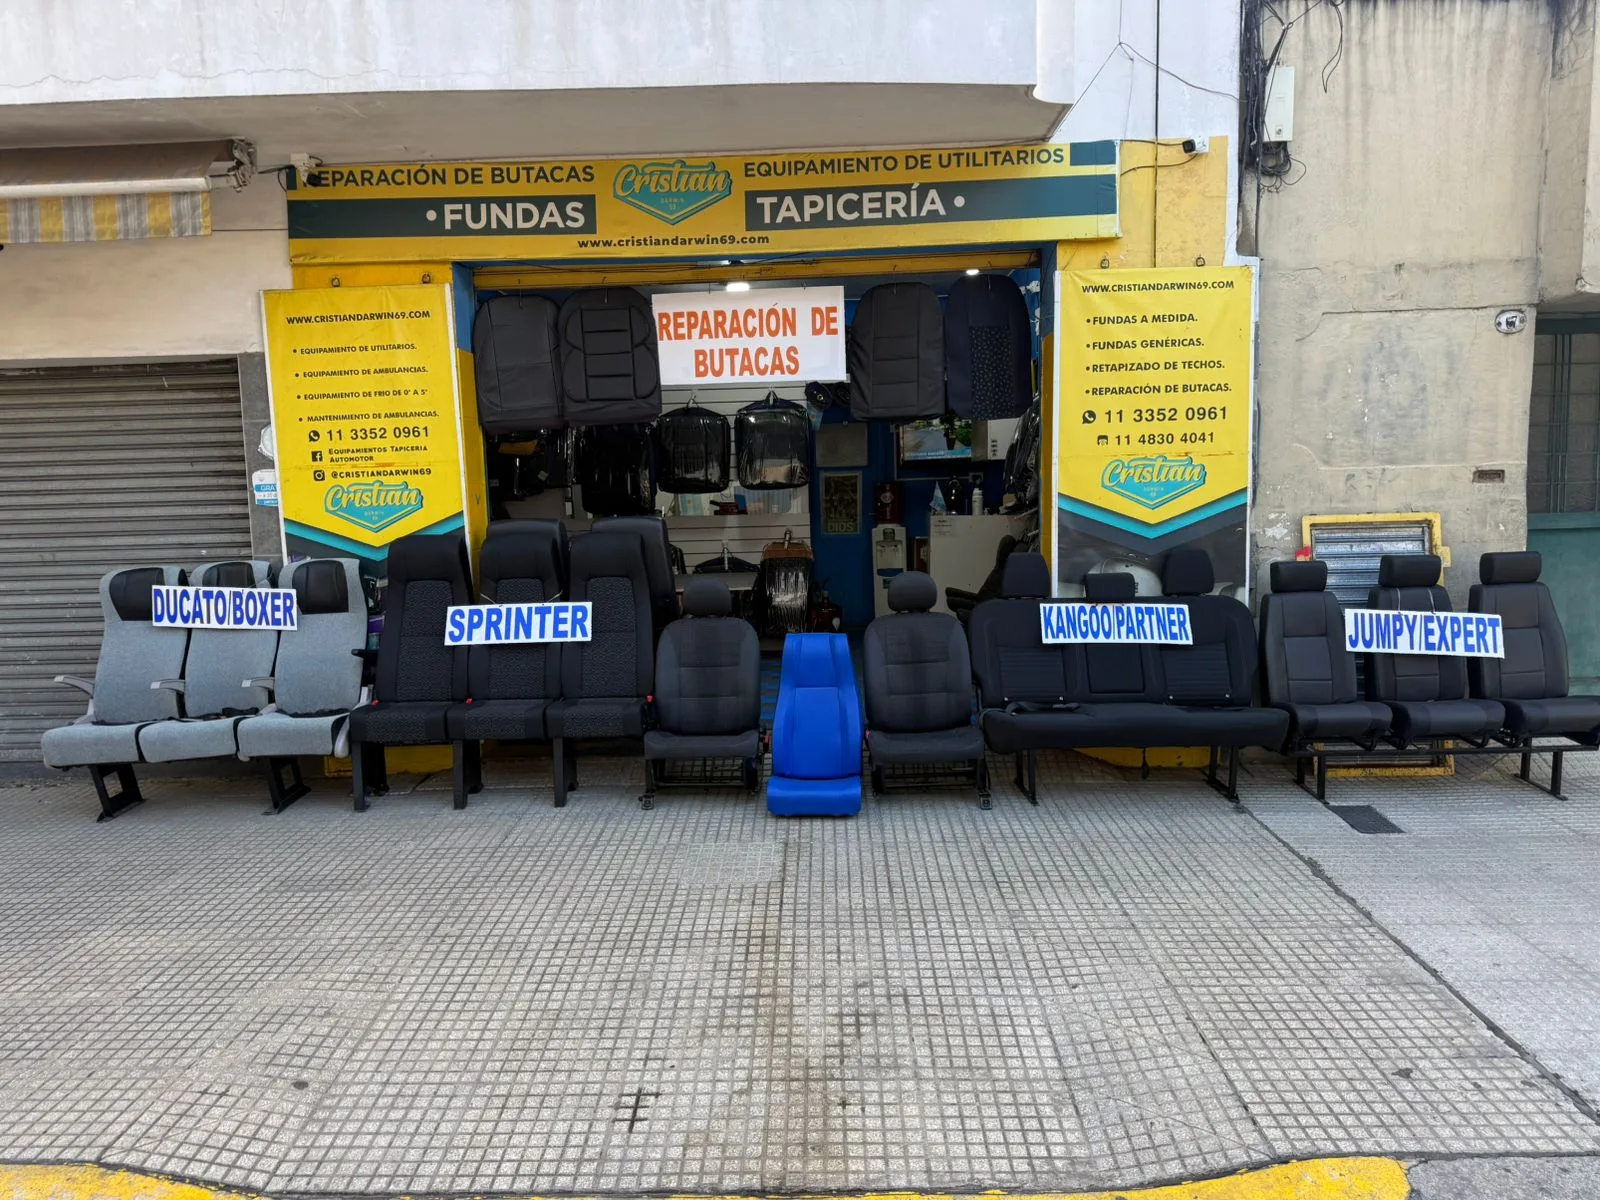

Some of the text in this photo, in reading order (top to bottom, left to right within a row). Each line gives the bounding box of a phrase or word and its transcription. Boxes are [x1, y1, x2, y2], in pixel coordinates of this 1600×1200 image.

[744, 147, 1064, 177] EQUIPAMIENTO DE UTILITARIOS
[303, 163, 595, 188] EPARACIÓN DE BUTACAS
[615, 161, 731, 197] Cristian
[757, 183, 946, 224] TAPICERÍA
[444, 201, 586, 231] FUNDAS
[577, 234, 769, 248] www.cristiandarwin69.com
[1082, 281, 1234, 293] WWW.CRISTIANDARWIN69.COM
[286, 311, 430, 325] WWW.CRISTIANDARWIN69.COM
[658, 302, 838, 341] REPARACIÓN DE
[1092, 313, 1198, 325] FUNDAS A MEDIDA.
[300, 346, 357, 355] EQUIPAMIENTO
[370, 343, 417, 352] UTILITARIOS.
[1092, 336, 1205, 350] FUNDAS GENÉRICAS.
[694, 346, 799, 378] BUTACAS
[1092, 360, 1225, 373] RETAPIZADO DE TECHOS.
[303, 369, 360, 378] EQUIPAMIENTO
[373, 366, 428, 375] AMBULANCIAS.
[304, 391, 360, 400] EQUIPAMIENTO
[1092, 382, 1232, 396] REPARACIÓN DE BUTACAS.
[307, 413, 370, 422] MANTENIMIENTO
[384, 410, 439, 419] AMBULANCIAS.
[1105, 406, 1227, 423] 11 3352 0961
[327, 426, 429, 441] 11 3352 0961
[1115, 432, 1214, 446] 11 4830 4041
[331, 468, 432, 478] @CRISTIANDARWIN69
[1103, 456, 1204, 488] Cristian
[326, 481, 420, 511] Cristian
[153, 588, 295, 627] DUCATO/BOXER
[448, 605, 589, 643] SPRINTER
[1042, 605, 1190, 641] KANGOO/PARTNER
[1348, 612, 1500, 654] JUMPY/EXPERT
